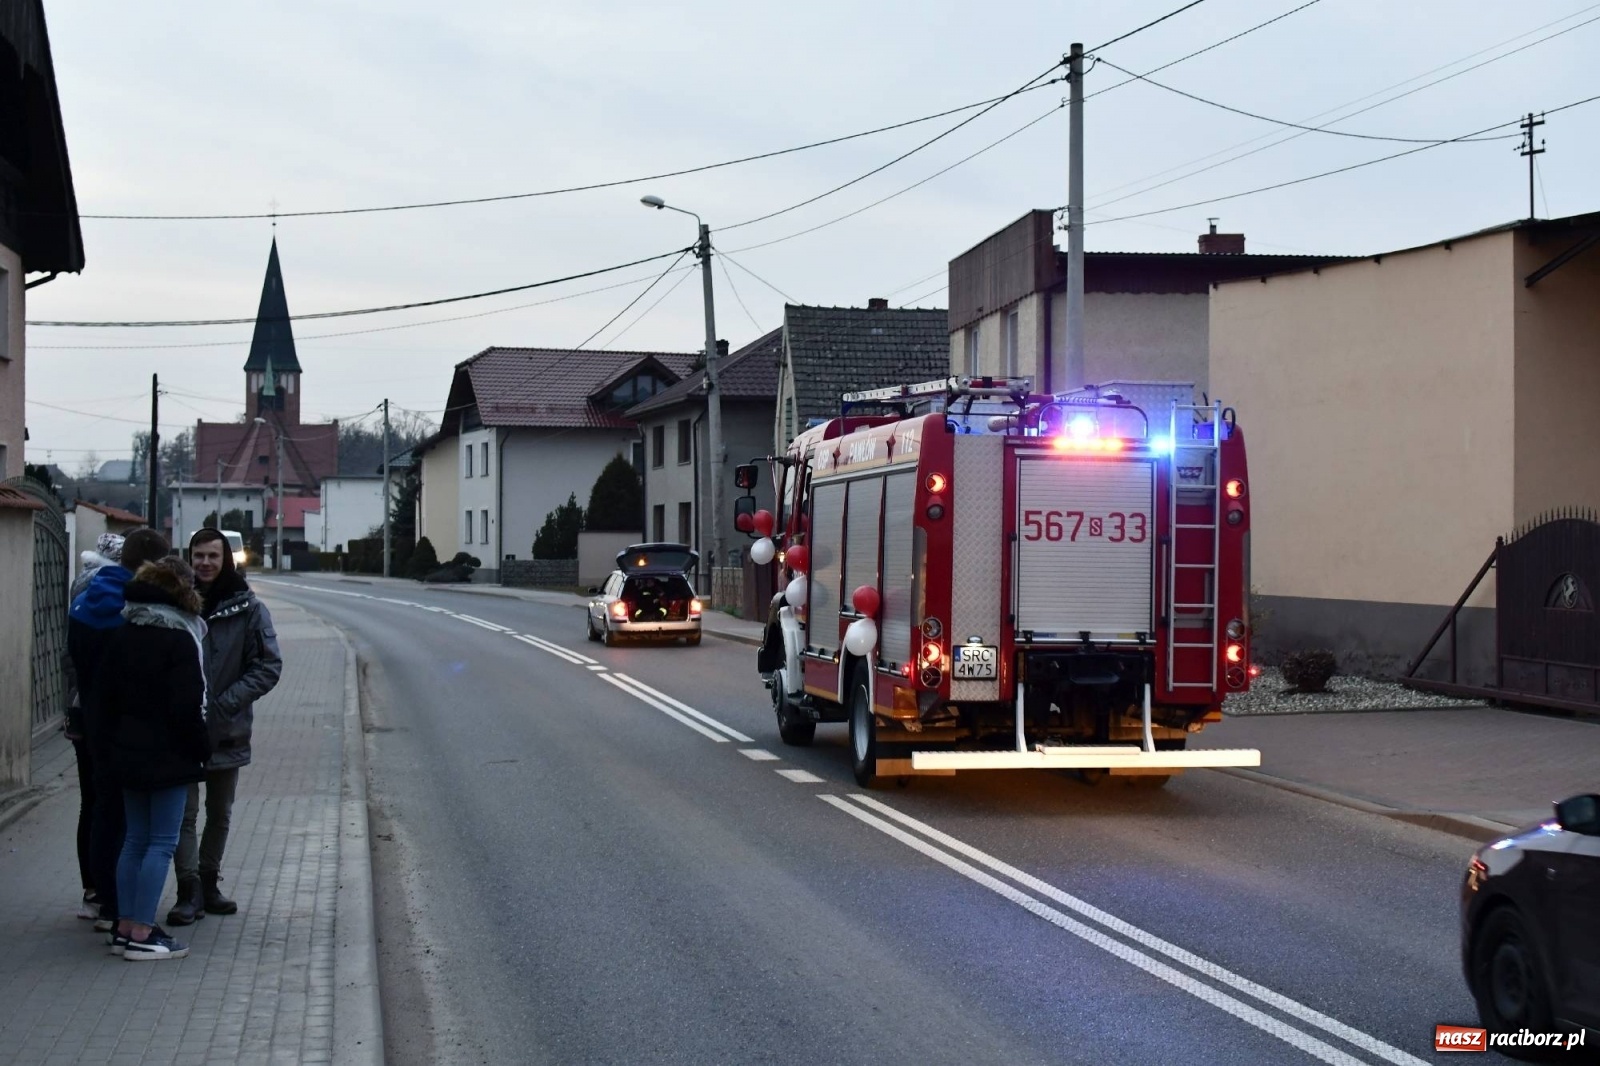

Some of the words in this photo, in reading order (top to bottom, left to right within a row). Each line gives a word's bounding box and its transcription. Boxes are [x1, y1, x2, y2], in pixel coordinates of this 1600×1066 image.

[901, 428, 915, 454] 112
[1024, 510, 1084, 542] 567
[1090, 518, 1102, 536] S
[1108, 512, 1147, 543] 33
[962, 649, 990, 662] SRC
